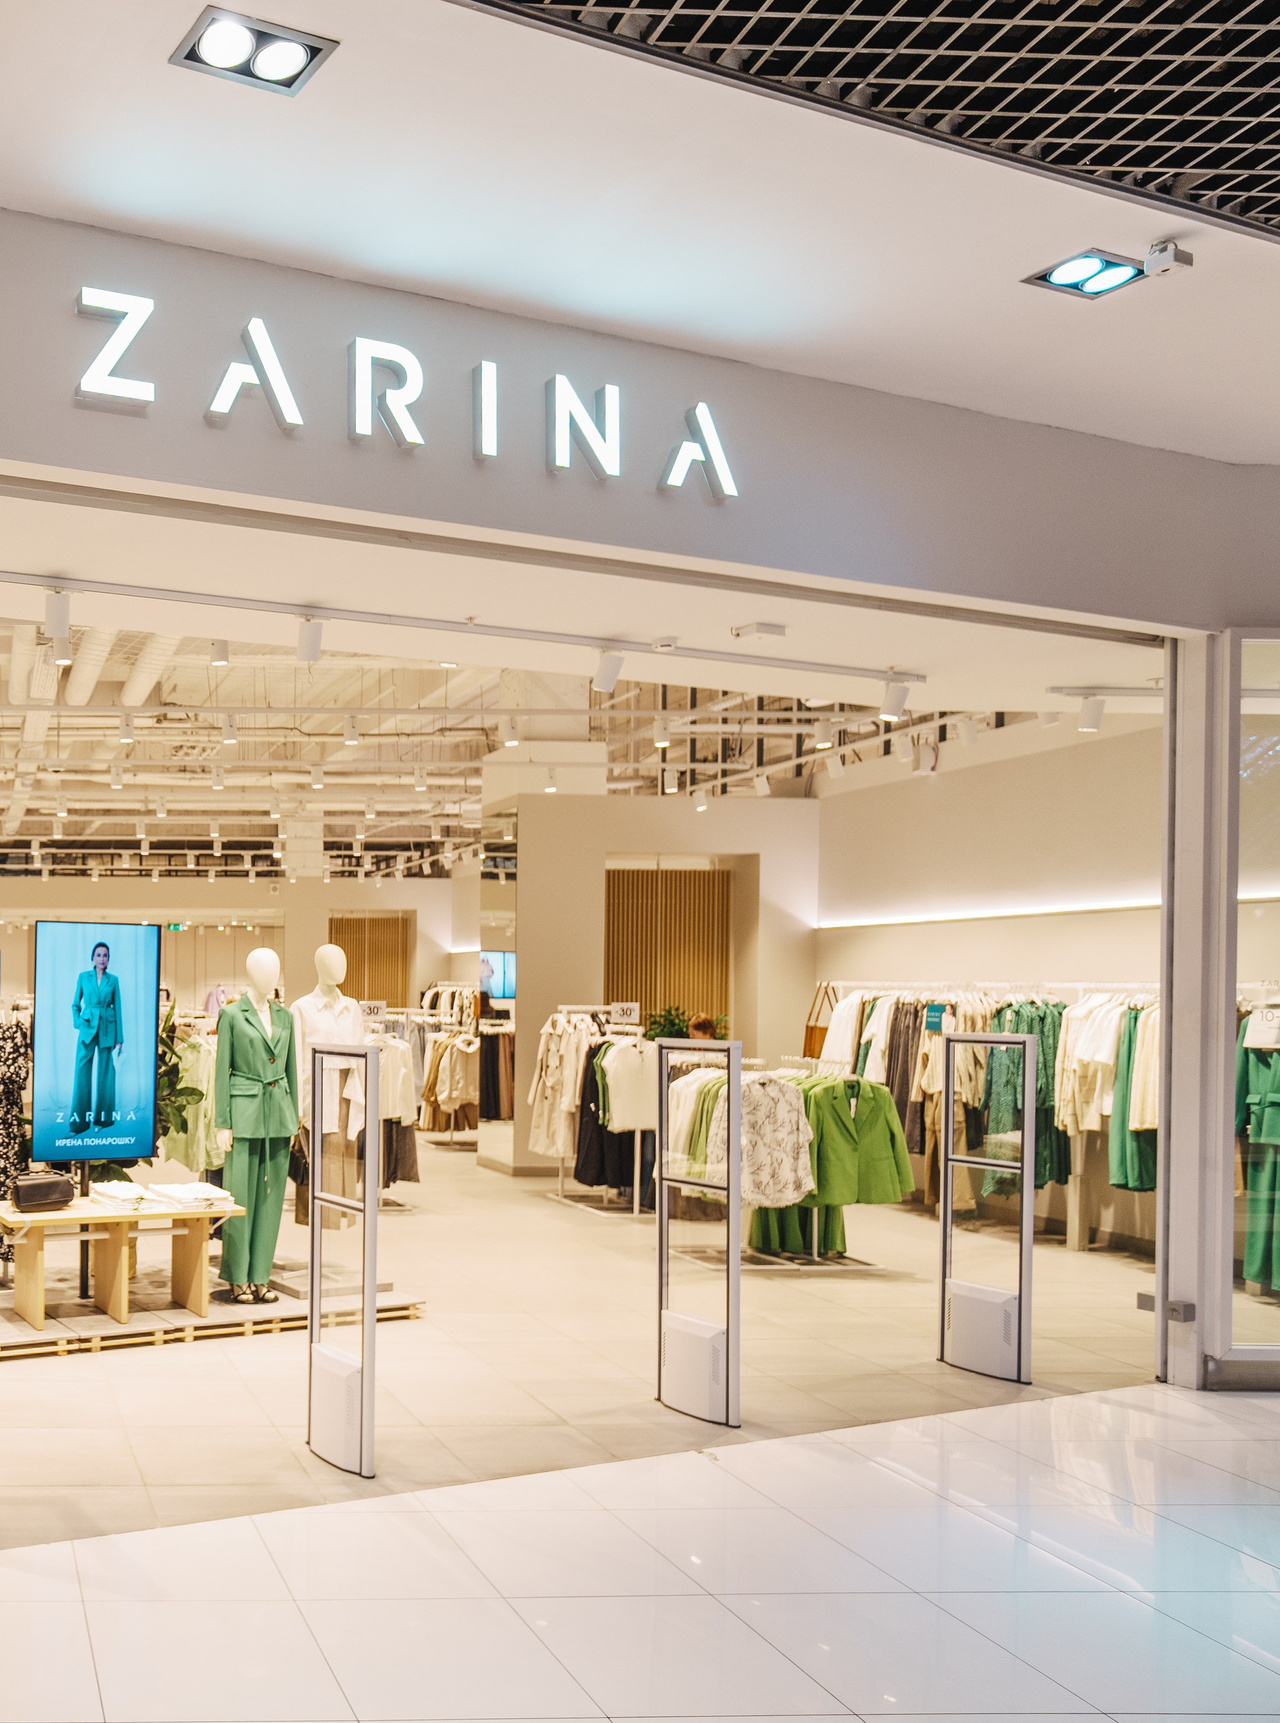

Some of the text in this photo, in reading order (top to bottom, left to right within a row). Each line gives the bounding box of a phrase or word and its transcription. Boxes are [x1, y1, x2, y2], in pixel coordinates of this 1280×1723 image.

[77, 286, 738, 498] ZARINA
[56, 1110, 136, 1123] ZARINA
[55, 1137, 136, 1147] ИРЕНА ПОНАРОШКУ
